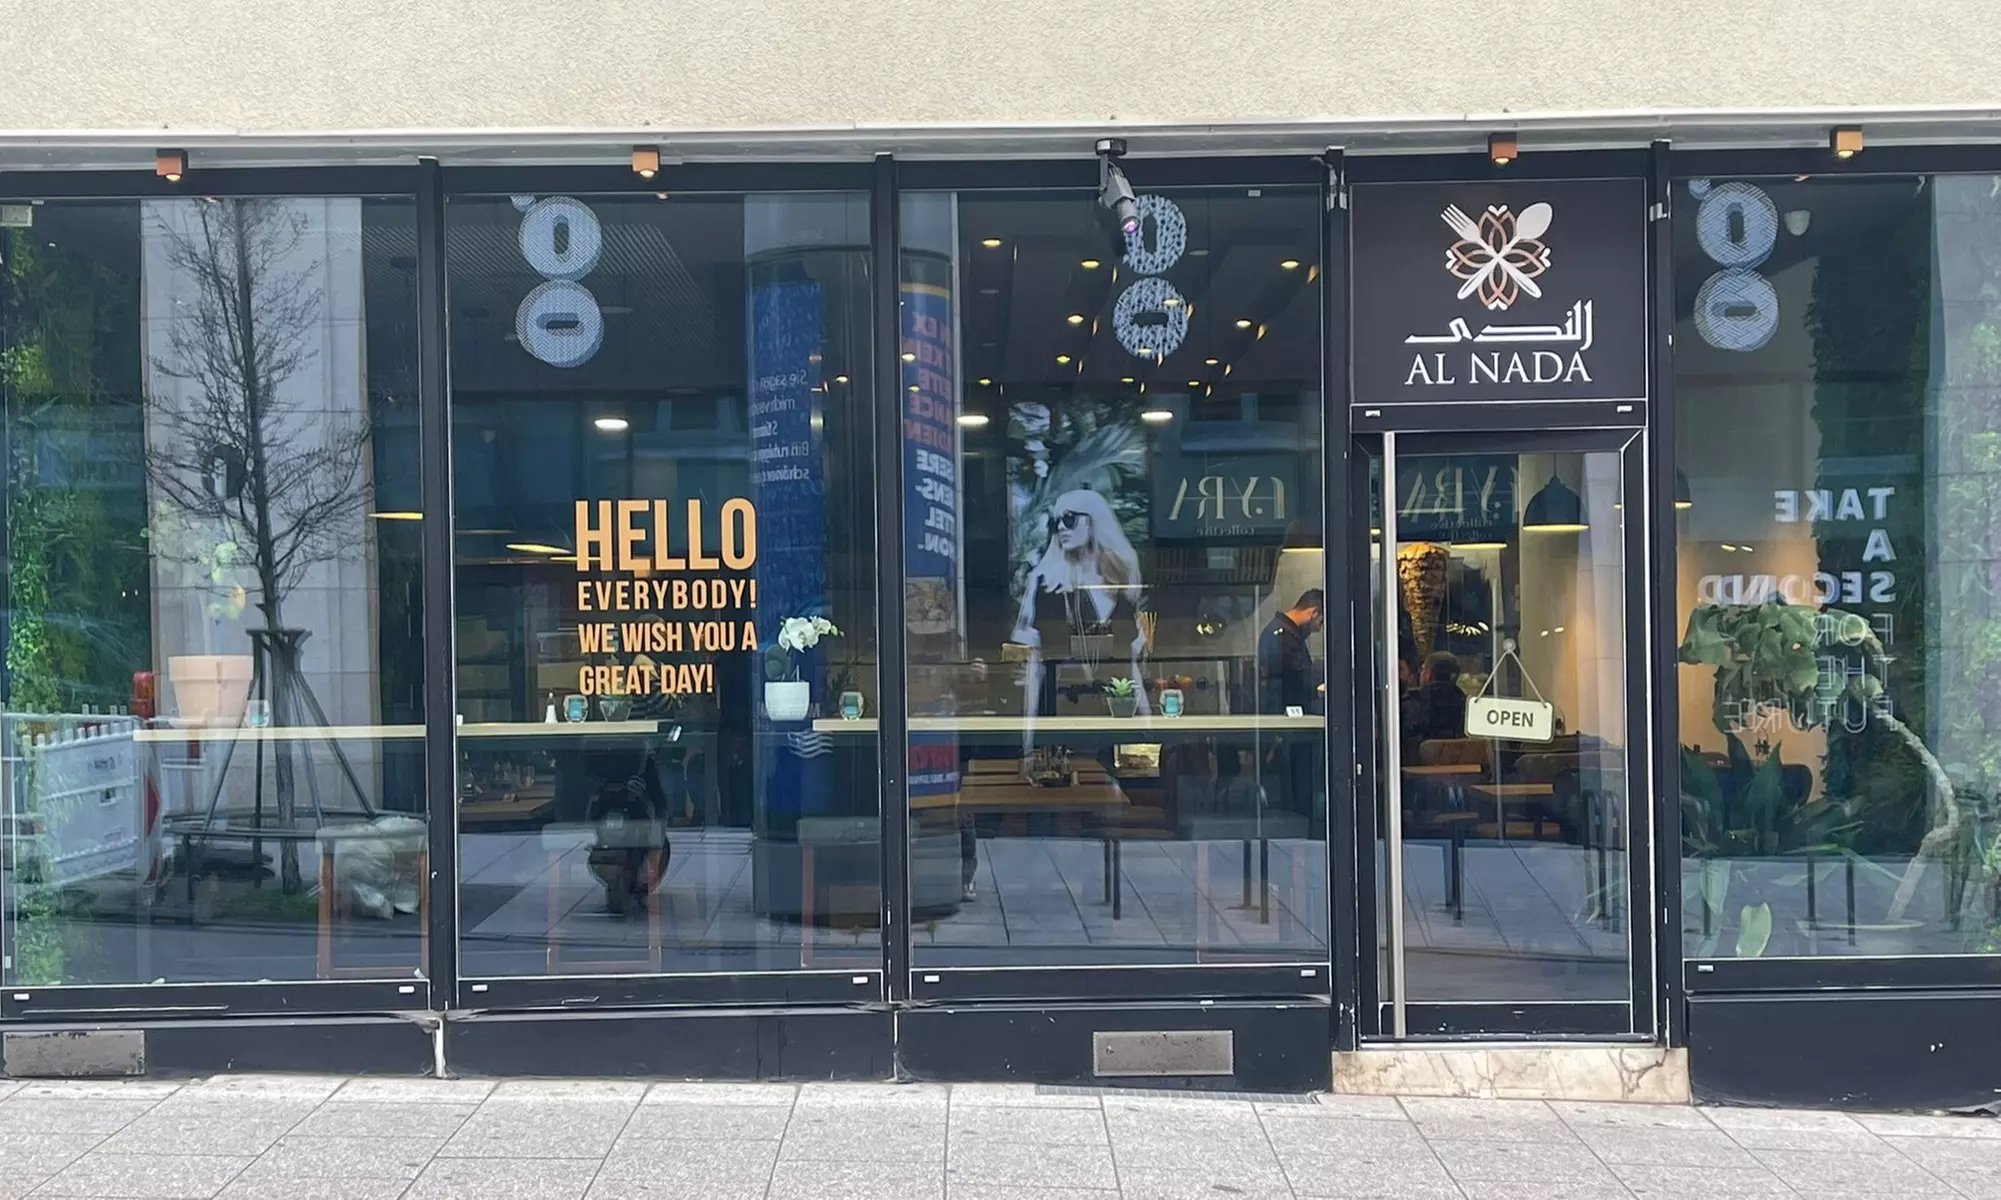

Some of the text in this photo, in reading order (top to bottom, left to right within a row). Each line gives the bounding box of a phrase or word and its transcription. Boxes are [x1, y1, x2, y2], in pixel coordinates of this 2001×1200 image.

[1404, 351, 1592, 385] AL NADA
[575, 497, 756, 571] HELLO
[577, 578, 757, 611] EVERYBODY!
[578, 620, 758, 653] WE WISH YOU A
[579, 663, 713, 696] GREAT DAY!
[1486, 709, 1534, 727] OPEN
